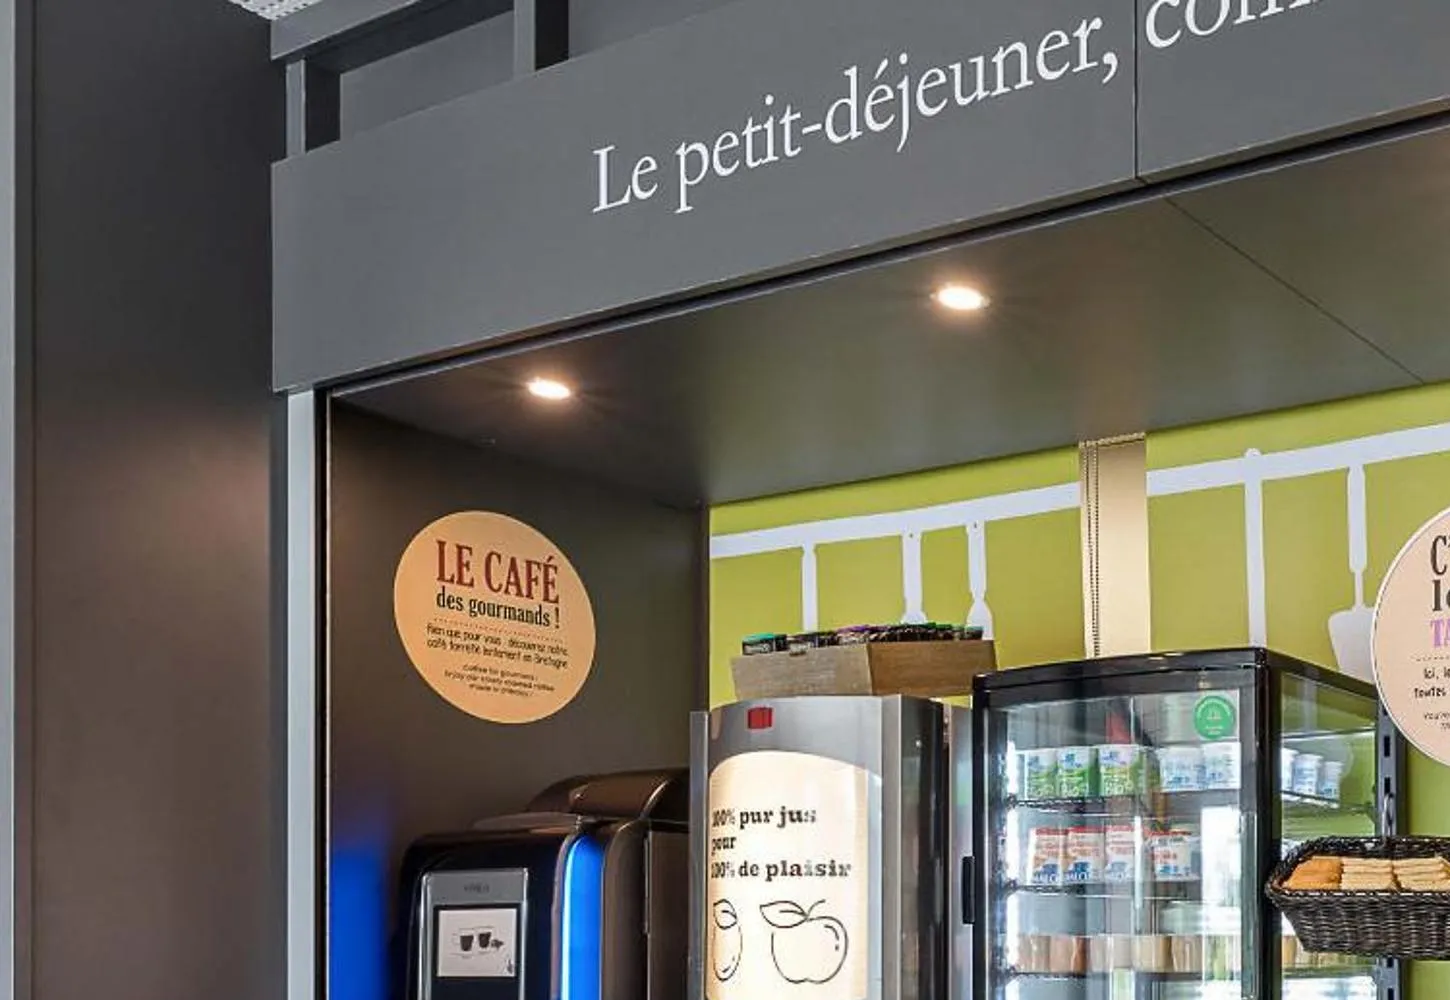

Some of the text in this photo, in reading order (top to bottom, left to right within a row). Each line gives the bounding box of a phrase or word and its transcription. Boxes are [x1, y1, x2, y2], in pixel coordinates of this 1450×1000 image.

[592, 144, 658, 213] Le
[674, 15, 1119, 215] petit-déjeuner,
[436, 540, 560, 604] LE CAFÉ
[436, 585, 464, 611] des
[469, 597, 550, 628] gourmands
[739, 809, 774, 830] pur
[776, 805, 817, 829] jus
[711, 836, 737, 857] pour
[738, 860, 760, 877] de
[765, 859, 852, 883] plaisir
